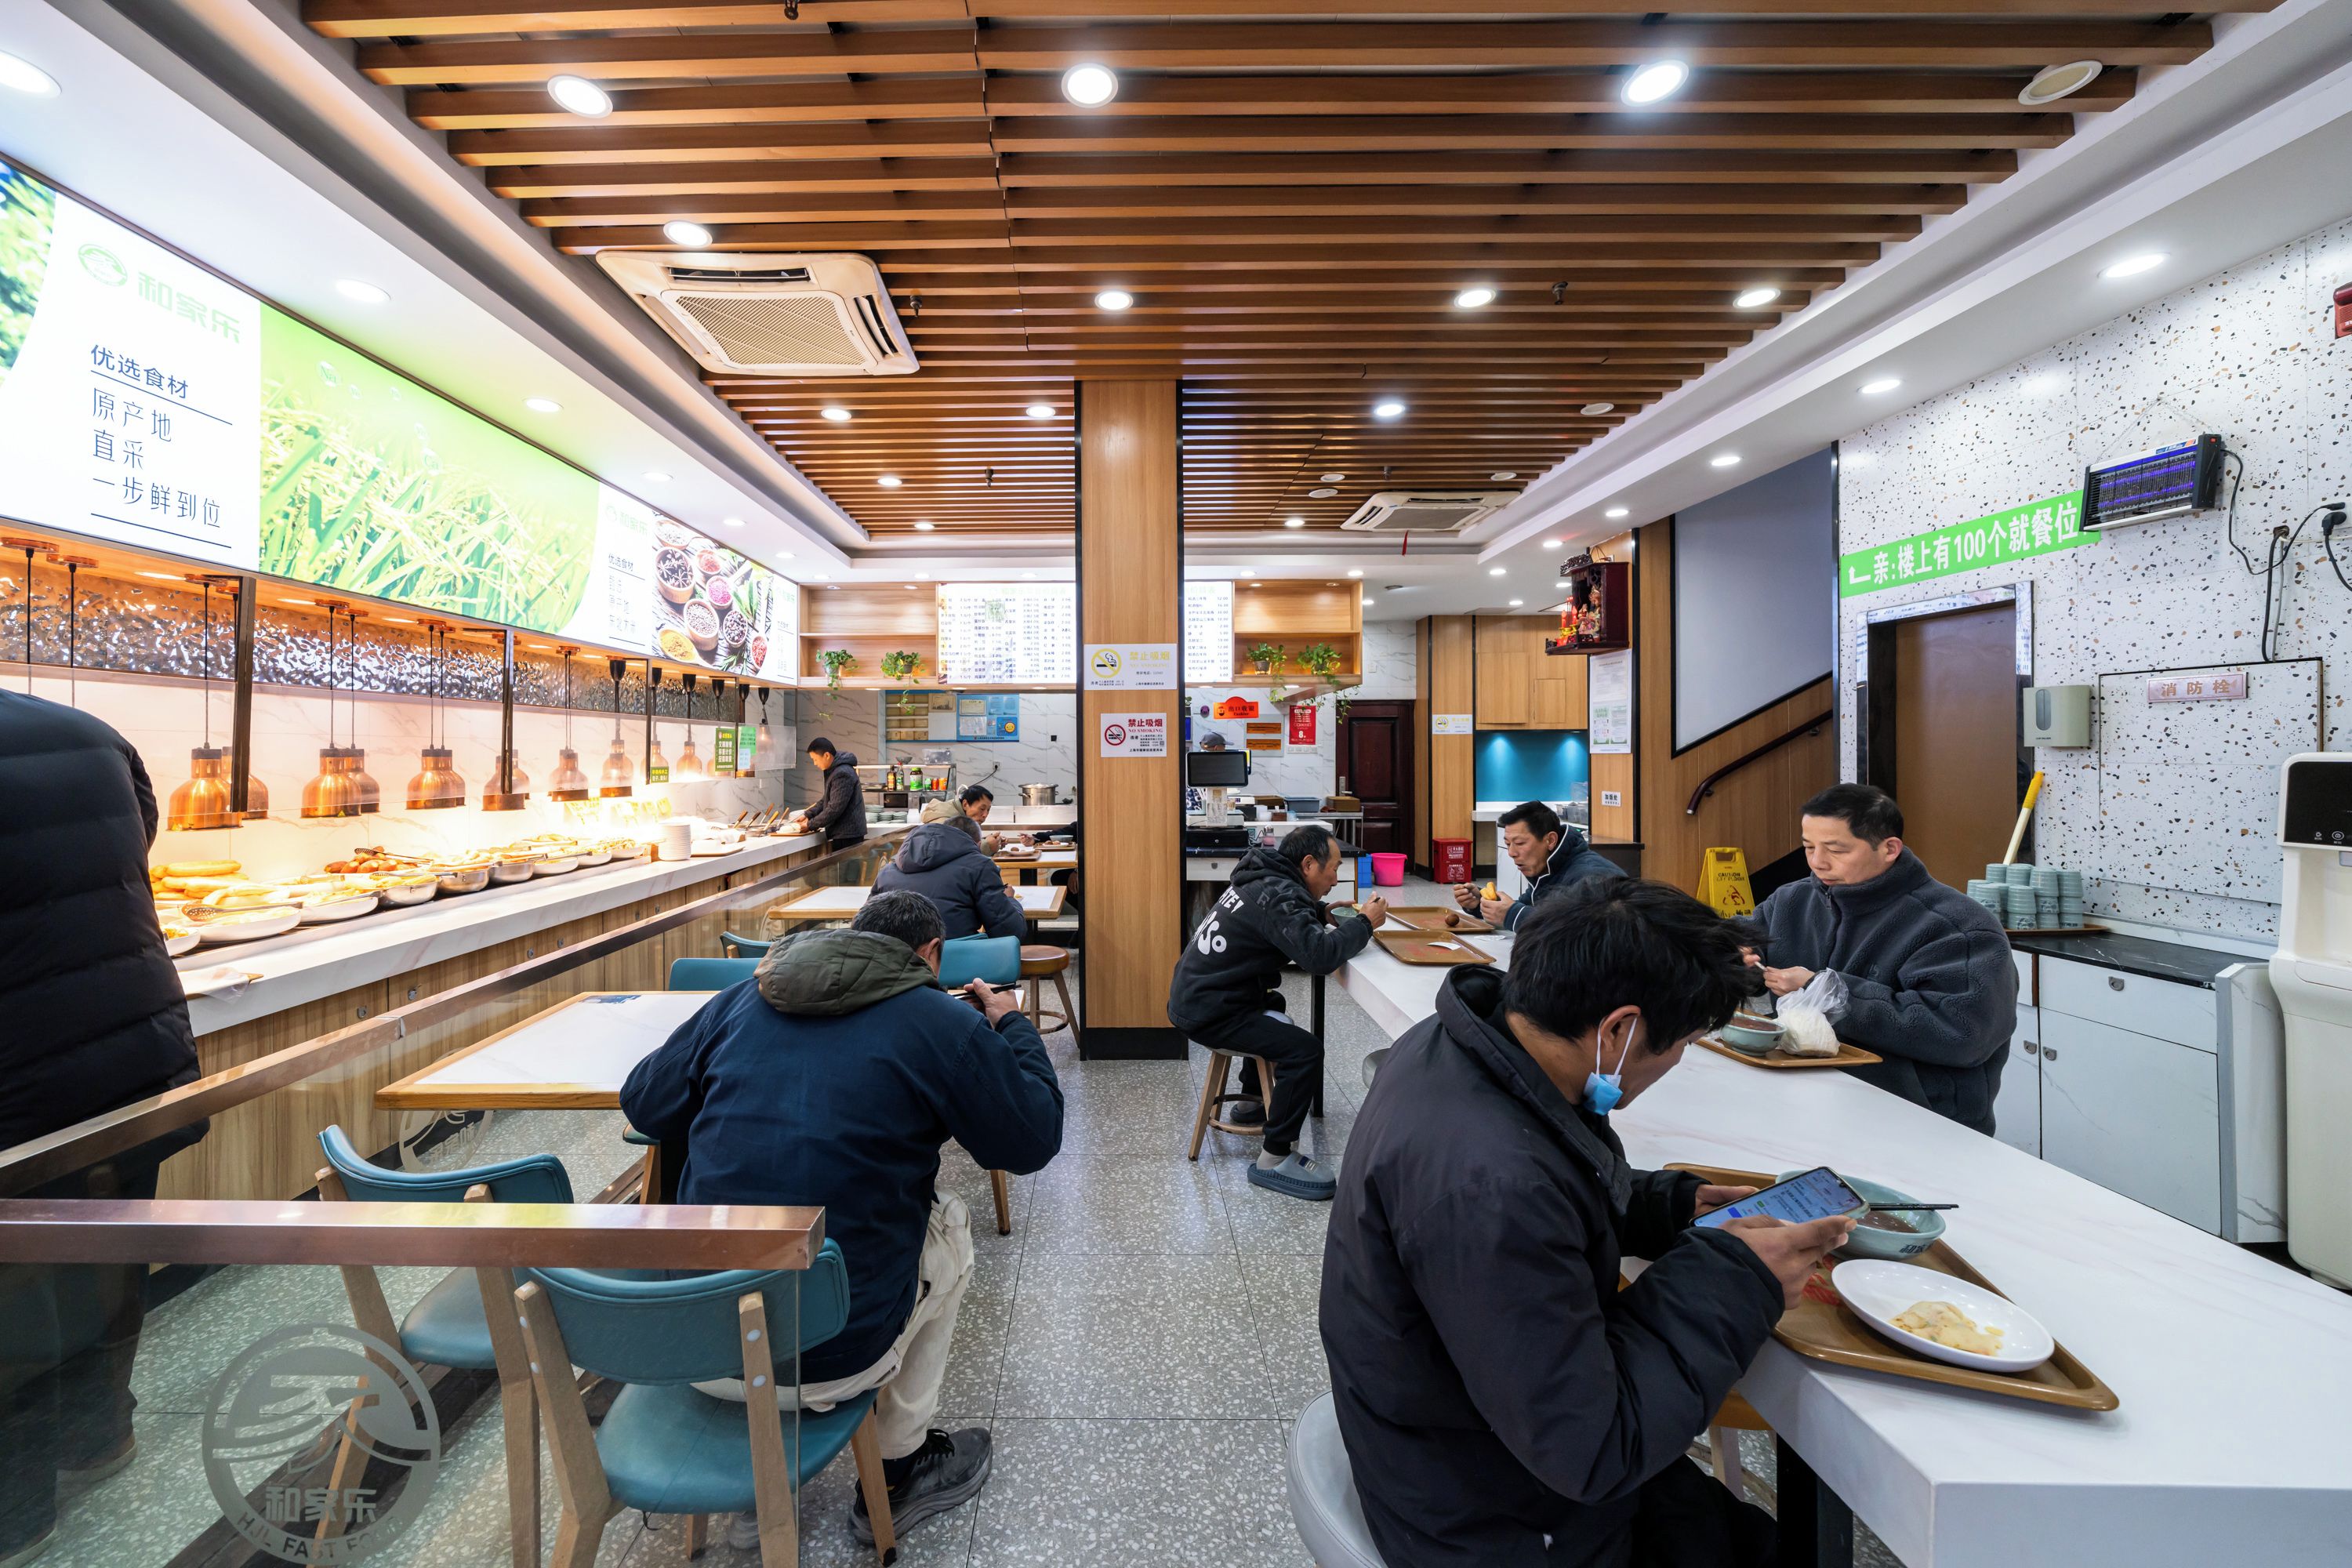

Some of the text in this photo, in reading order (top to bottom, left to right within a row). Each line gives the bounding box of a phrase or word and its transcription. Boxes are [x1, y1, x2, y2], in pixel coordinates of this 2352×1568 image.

[138, 270, 241, 344] 和家乐
[90, 343, 190, 400] 优选食材
[93, 387, 172, 443] 原产地
[93, 429, 143, 470] 直采
[93, 475, 222, 530] 一步鲜到位
[1873, 500, 2090, 585] 亲:楼上有100个就餐位
[608, 552, 634, 572] 优选食材
[1129, 651, 1171, 661] 禁止吸烟
[2161, 679, 2230, 697] 消防栓
[1128, 718, 1163, 728] 禁止吸烟
[265, 1488, 377, 1523] 和家乐
[282, 1537, 336, 1559] FAST
